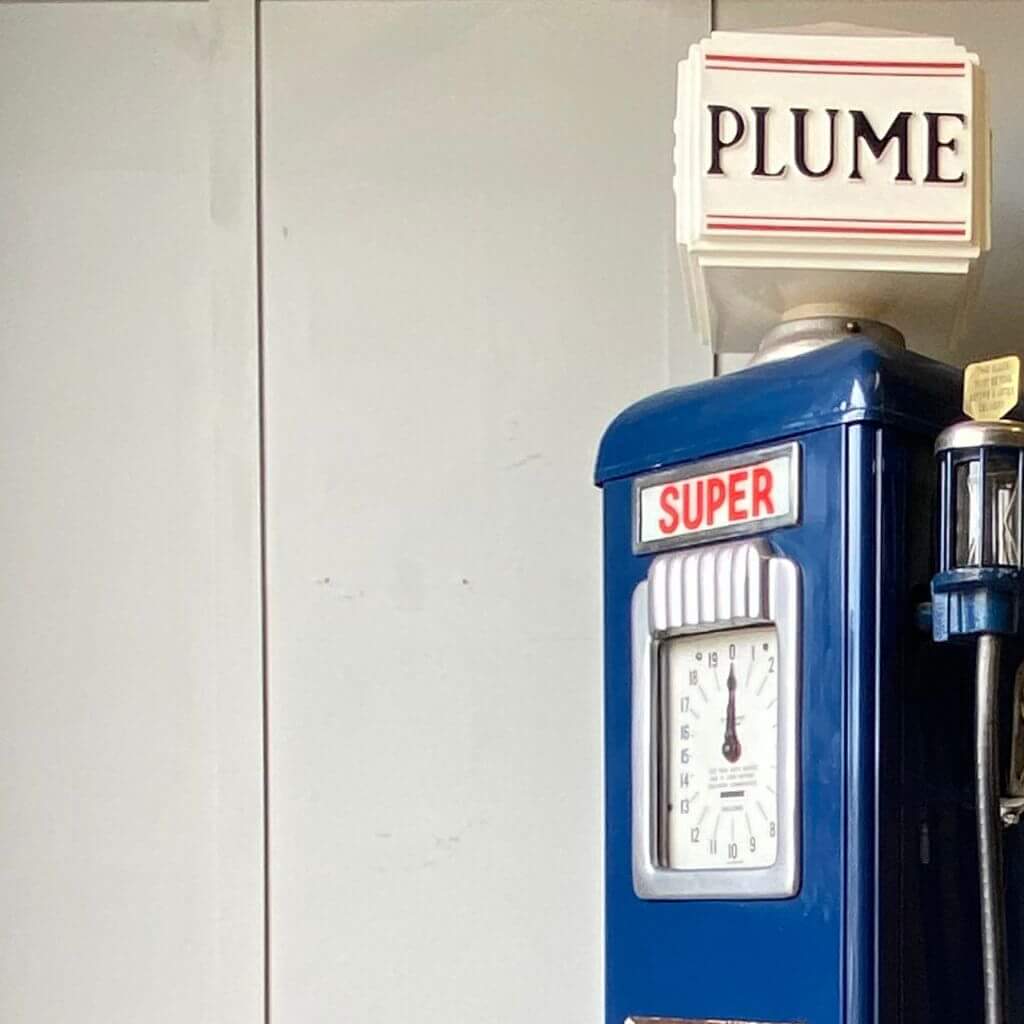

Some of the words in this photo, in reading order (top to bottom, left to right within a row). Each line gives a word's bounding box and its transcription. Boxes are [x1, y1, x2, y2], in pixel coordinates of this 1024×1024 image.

[706, 104, 966, 184] PLUME
[658, 467, 775, 534] SUPER
[708, 651, 718, 668] 19
[728, 643, 736, 661] 0
[767, 656, 775, 673] 2
[680, 696, 690, 713] 17
[680, 772, 690, 788] 14
[680, 799, 690, 814] 13
[691, 826, 700, 843] 12
[769, 821, 776, 837] 8
[710, 839, 717, 854] 11
[728, 843, 738, 859] 10
[749, 836, 756, 852] 9
